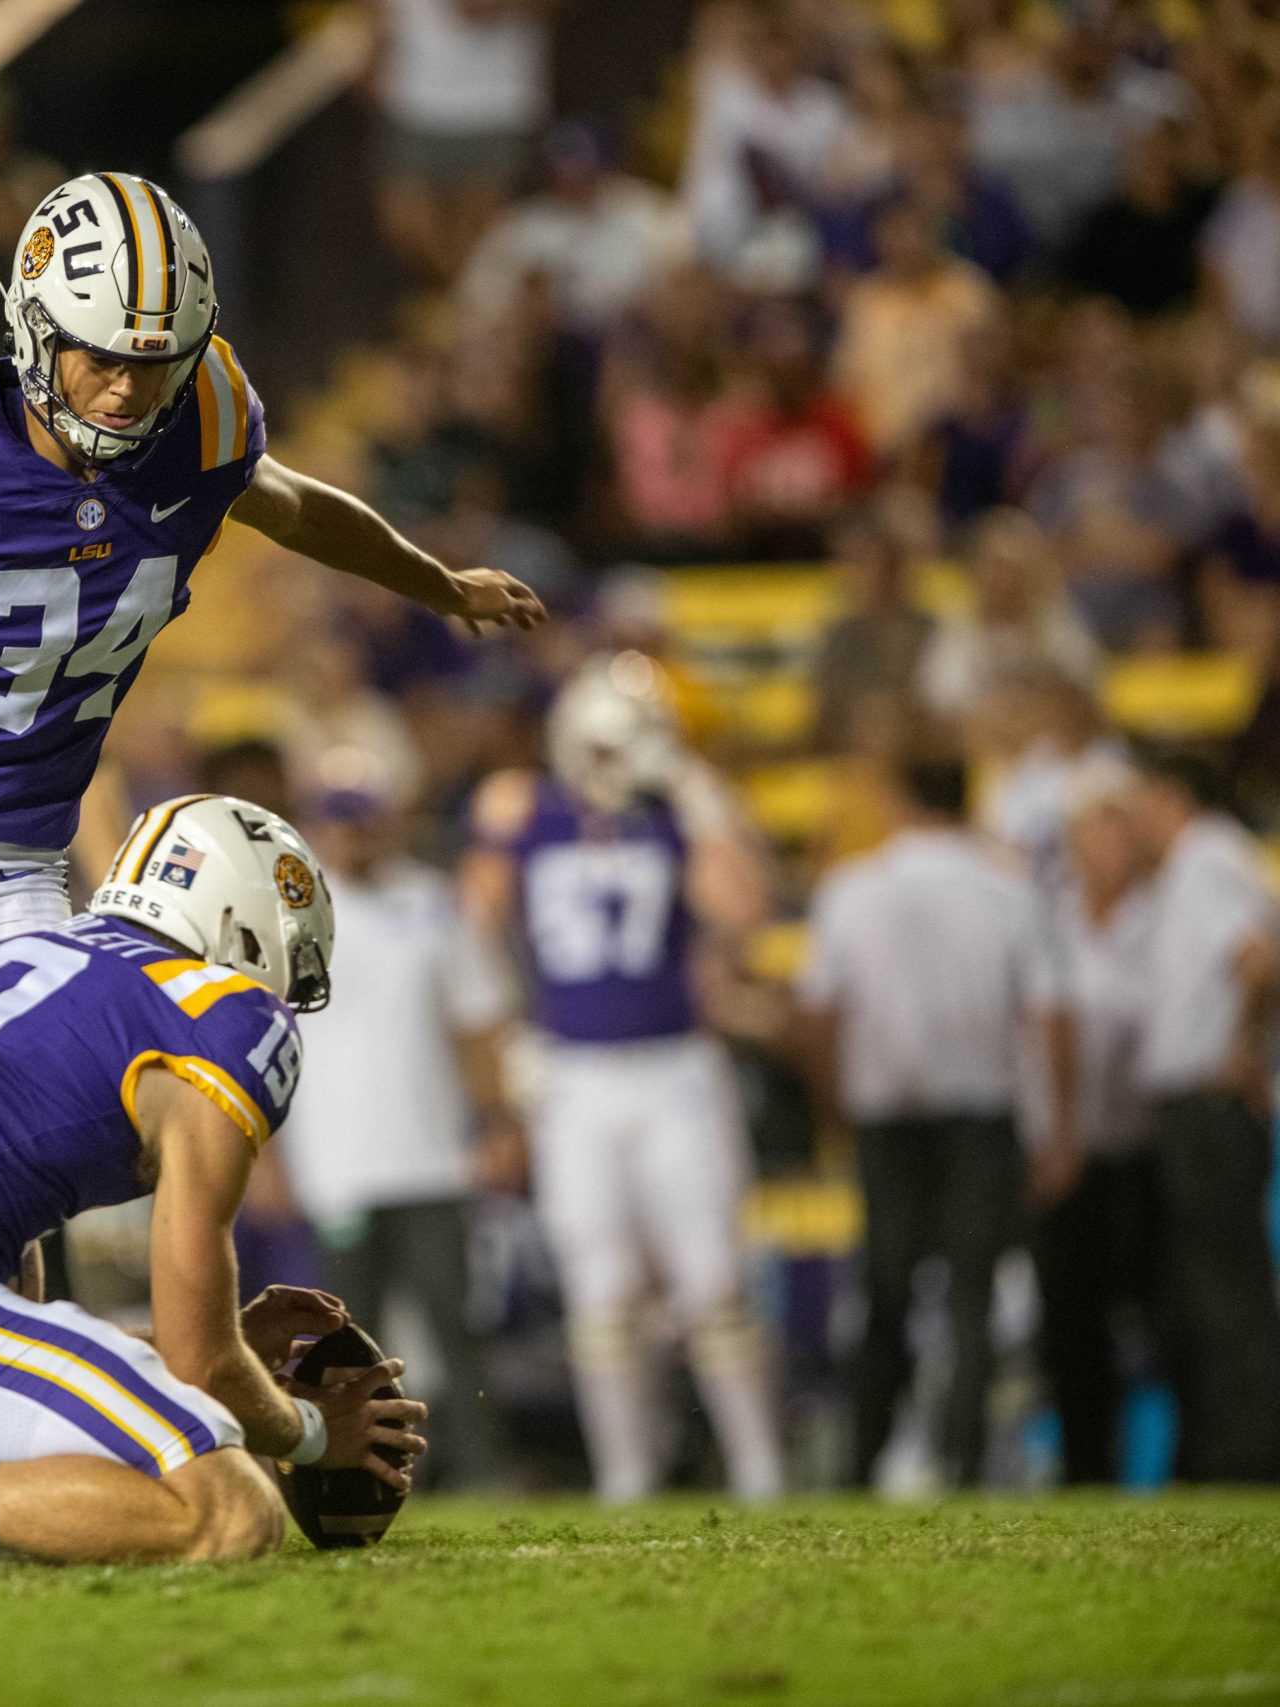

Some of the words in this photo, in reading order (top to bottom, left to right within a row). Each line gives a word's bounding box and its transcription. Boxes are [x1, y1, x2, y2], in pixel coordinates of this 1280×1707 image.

[131, 337, 169, 352] LSU
[68, 542, 112, 562] LSU
[245, 1010, 303, 1108] 19
